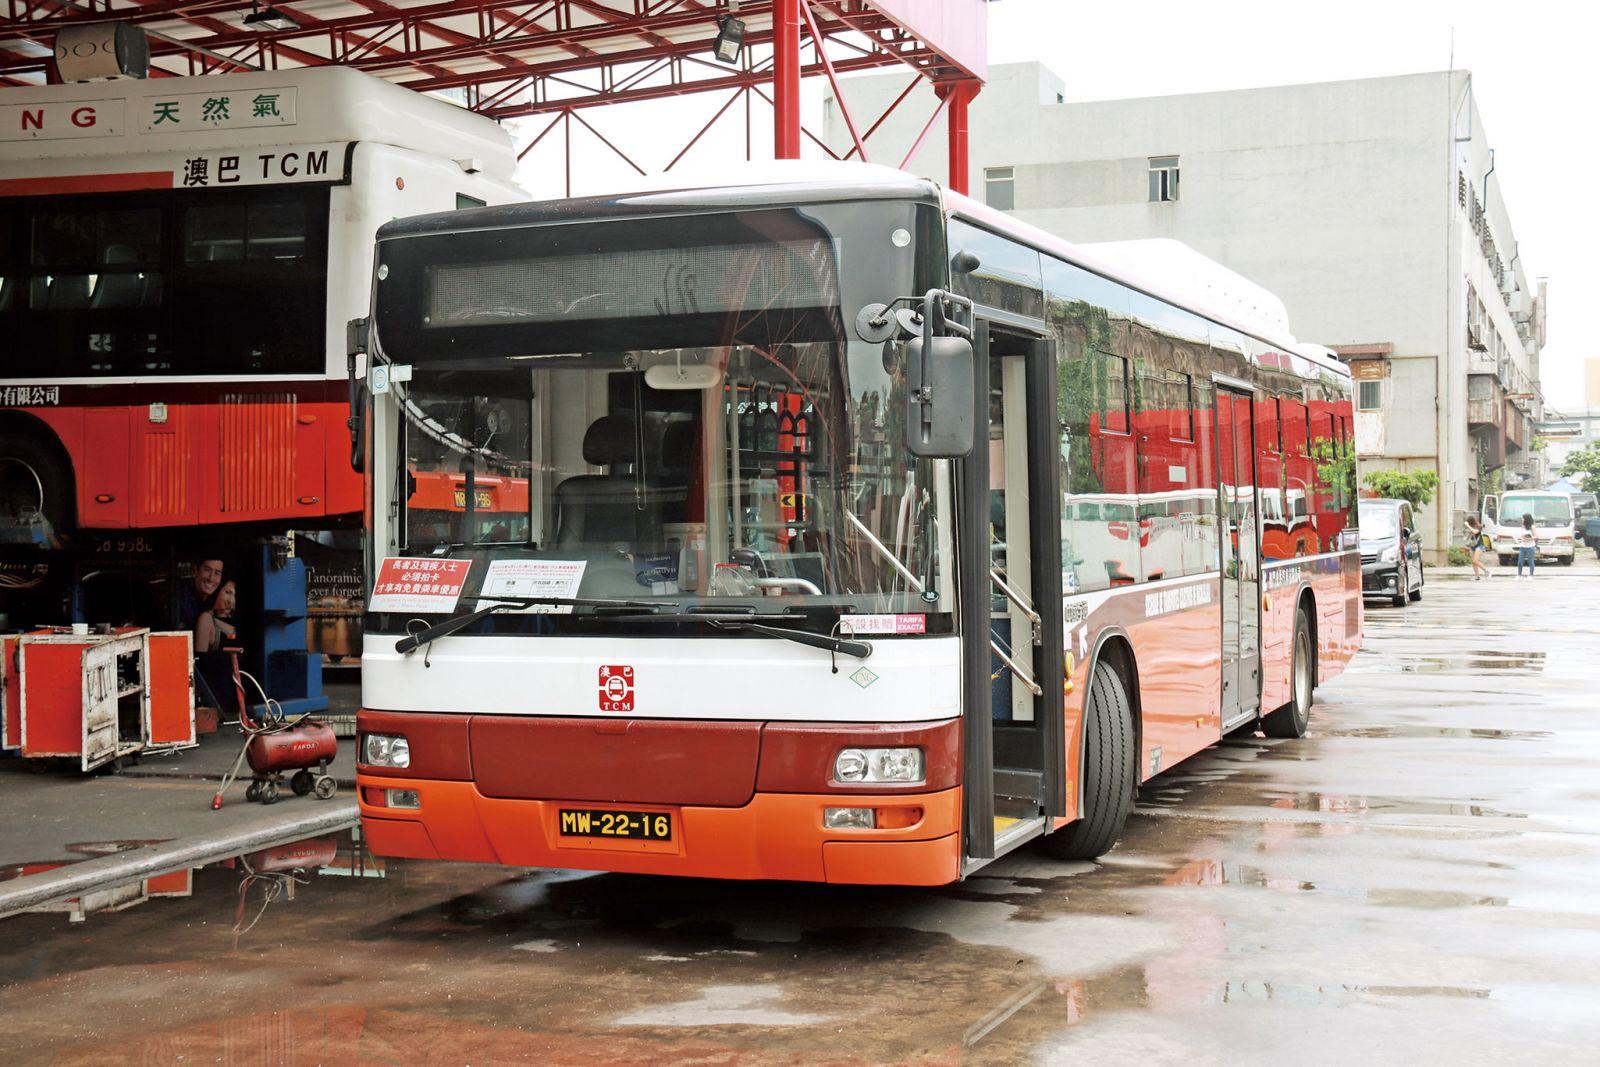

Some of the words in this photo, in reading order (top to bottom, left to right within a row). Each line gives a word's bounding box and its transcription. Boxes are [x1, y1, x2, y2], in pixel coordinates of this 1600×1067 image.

[152, 93, 281, 125] 天然氣
[183, 156, 240, 188] 澳巴
[258, 150, 329, 179] TCM
[0, 386, 60, 406] 有限公司
[400, 572, 440, 583] 必須拍卡
[376, 582, 460, 595] 才享有免費乘車優惠
[600, 666, 633, 678] 澳巴
[603, 702, 631, 711] TCM
[561, 812, 669, 838] MW-22-16
